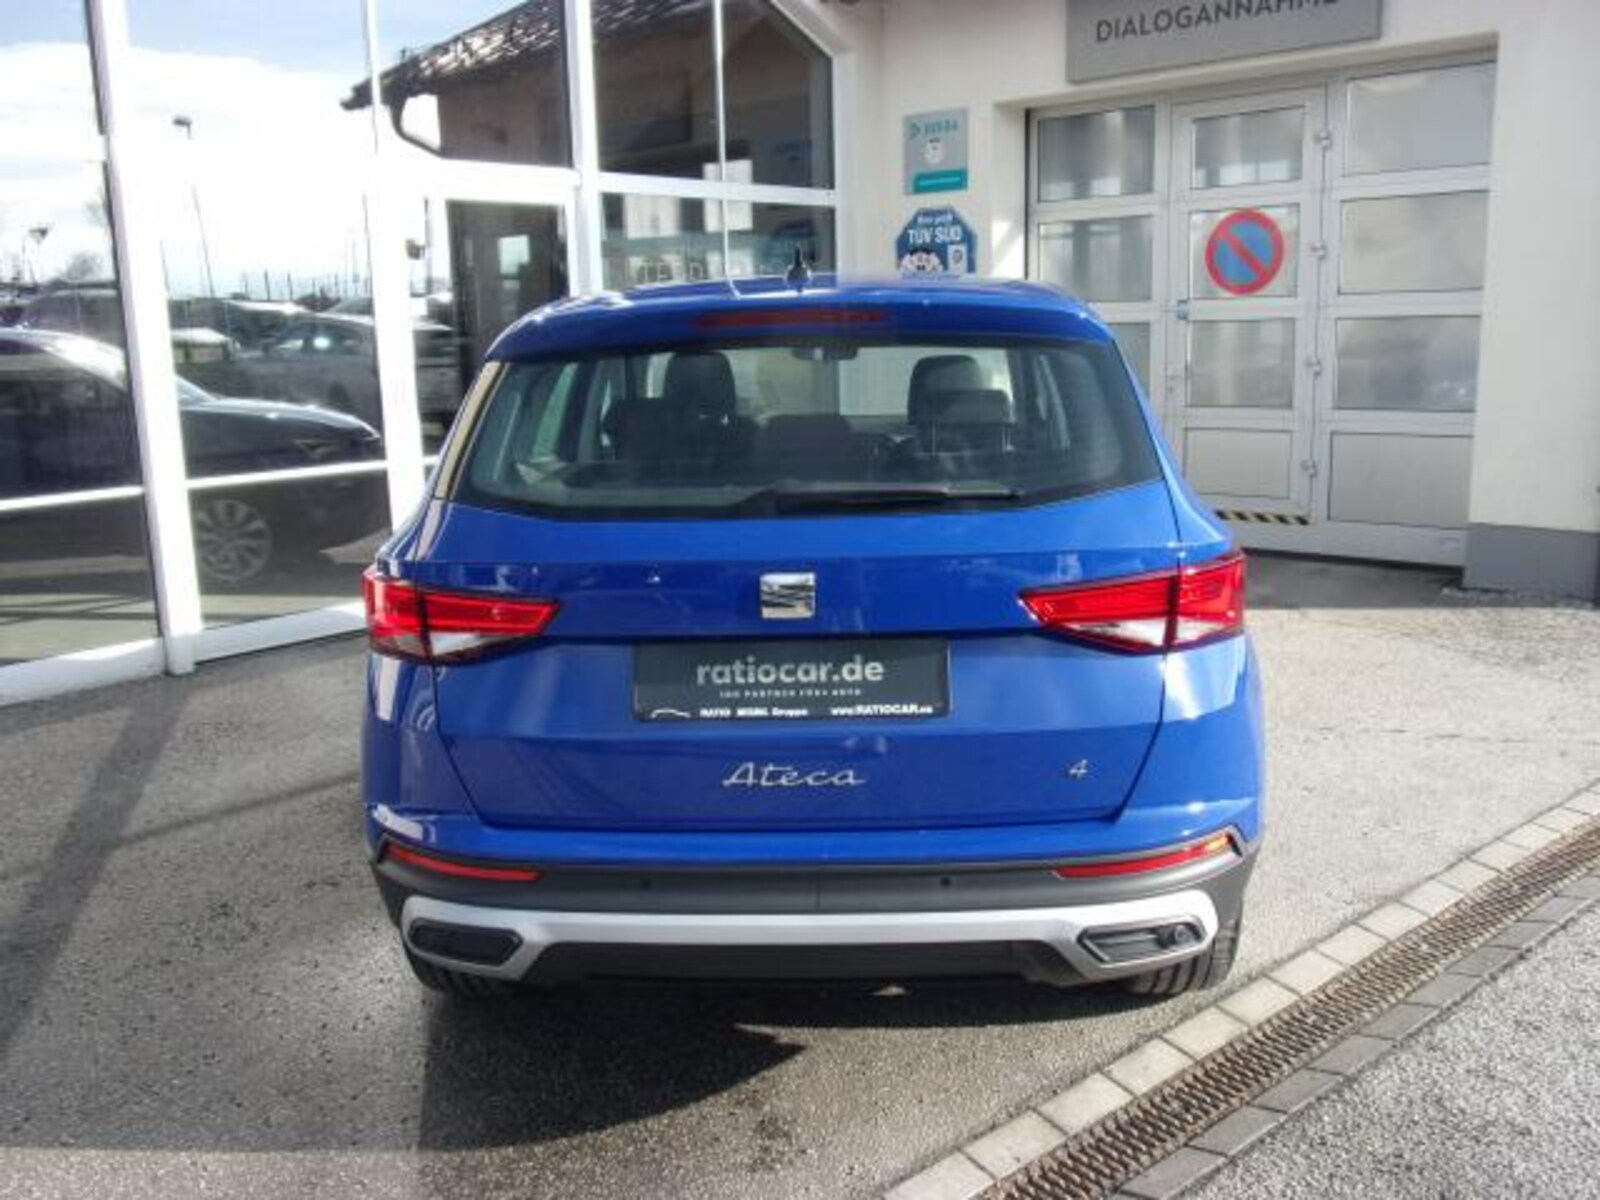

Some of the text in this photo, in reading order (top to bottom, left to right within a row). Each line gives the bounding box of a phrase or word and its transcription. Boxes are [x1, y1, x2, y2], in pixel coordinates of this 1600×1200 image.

[1095, 0, 1338, 42] DIALOGANNAH
[696, 654, 884, 685] ratiocar.de
[721, 761, 866, 788] Ateca
[1066, 759, 1090, 778] 4
